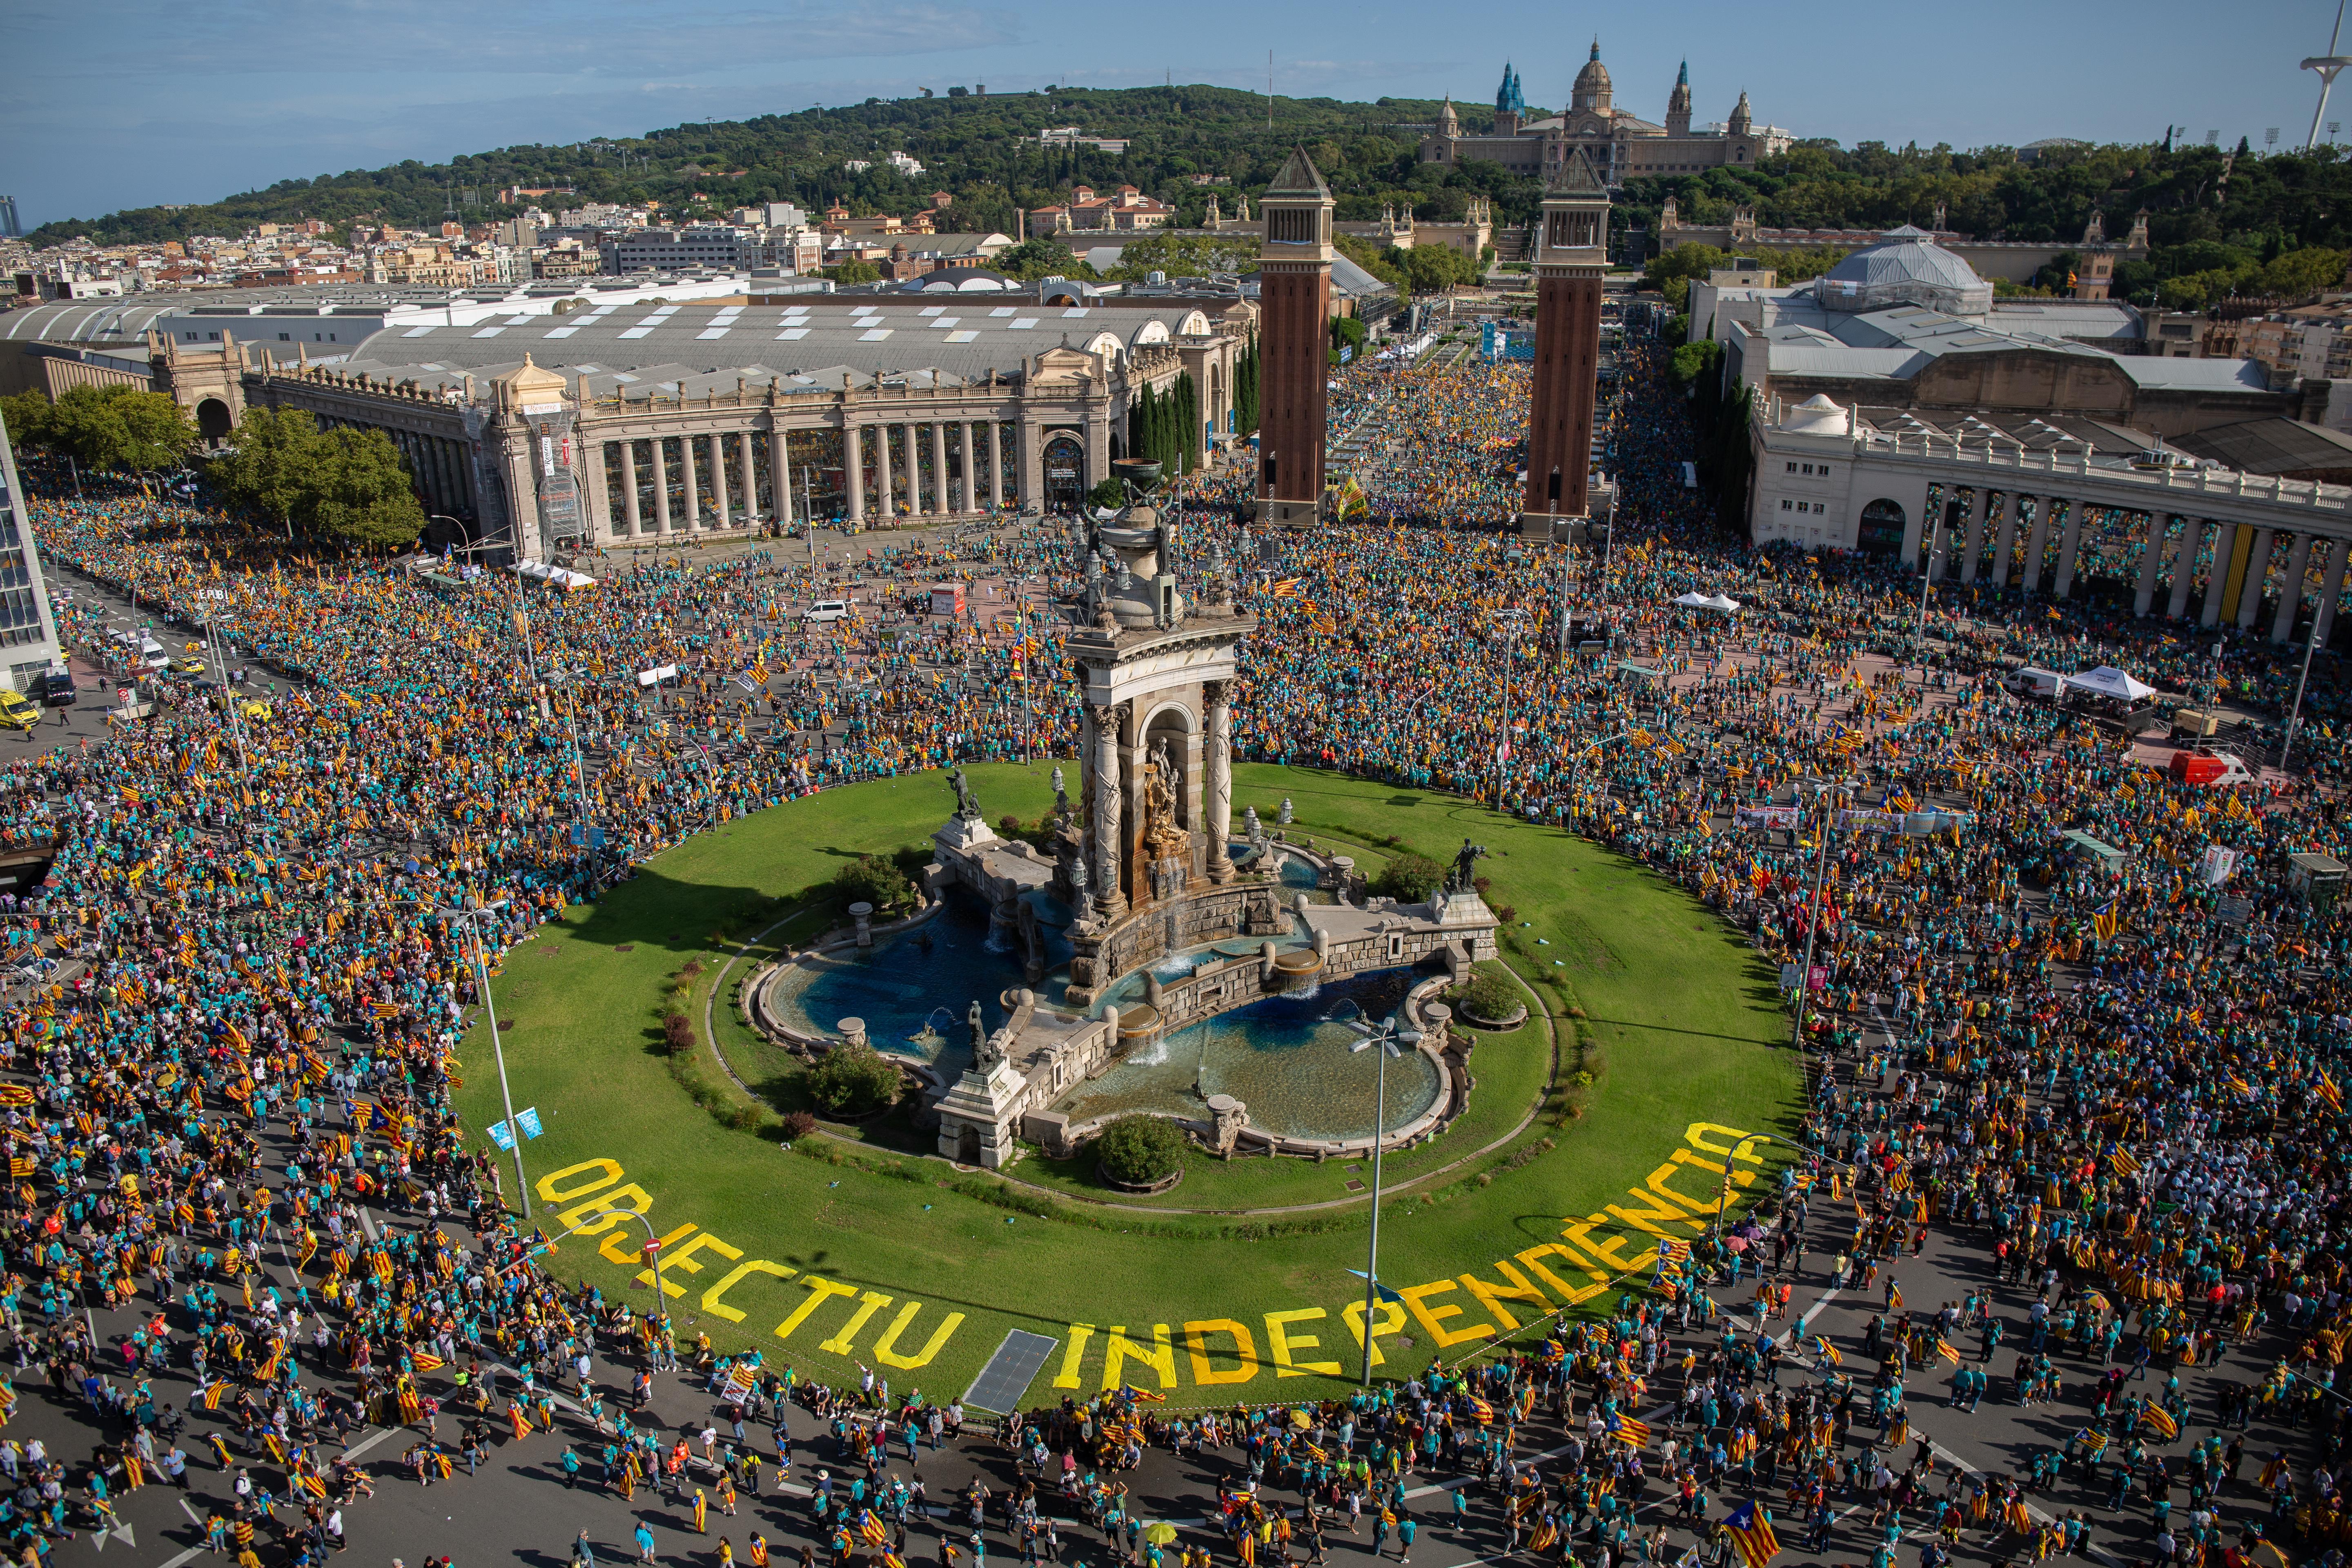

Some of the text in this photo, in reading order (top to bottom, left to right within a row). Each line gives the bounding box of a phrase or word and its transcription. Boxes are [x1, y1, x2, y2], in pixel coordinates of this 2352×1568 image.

[1849, 818, 1893, 826] DIGNITAT
[535, 1122, 1771, 1390] OBJECTIU INDEPENDENCIA
